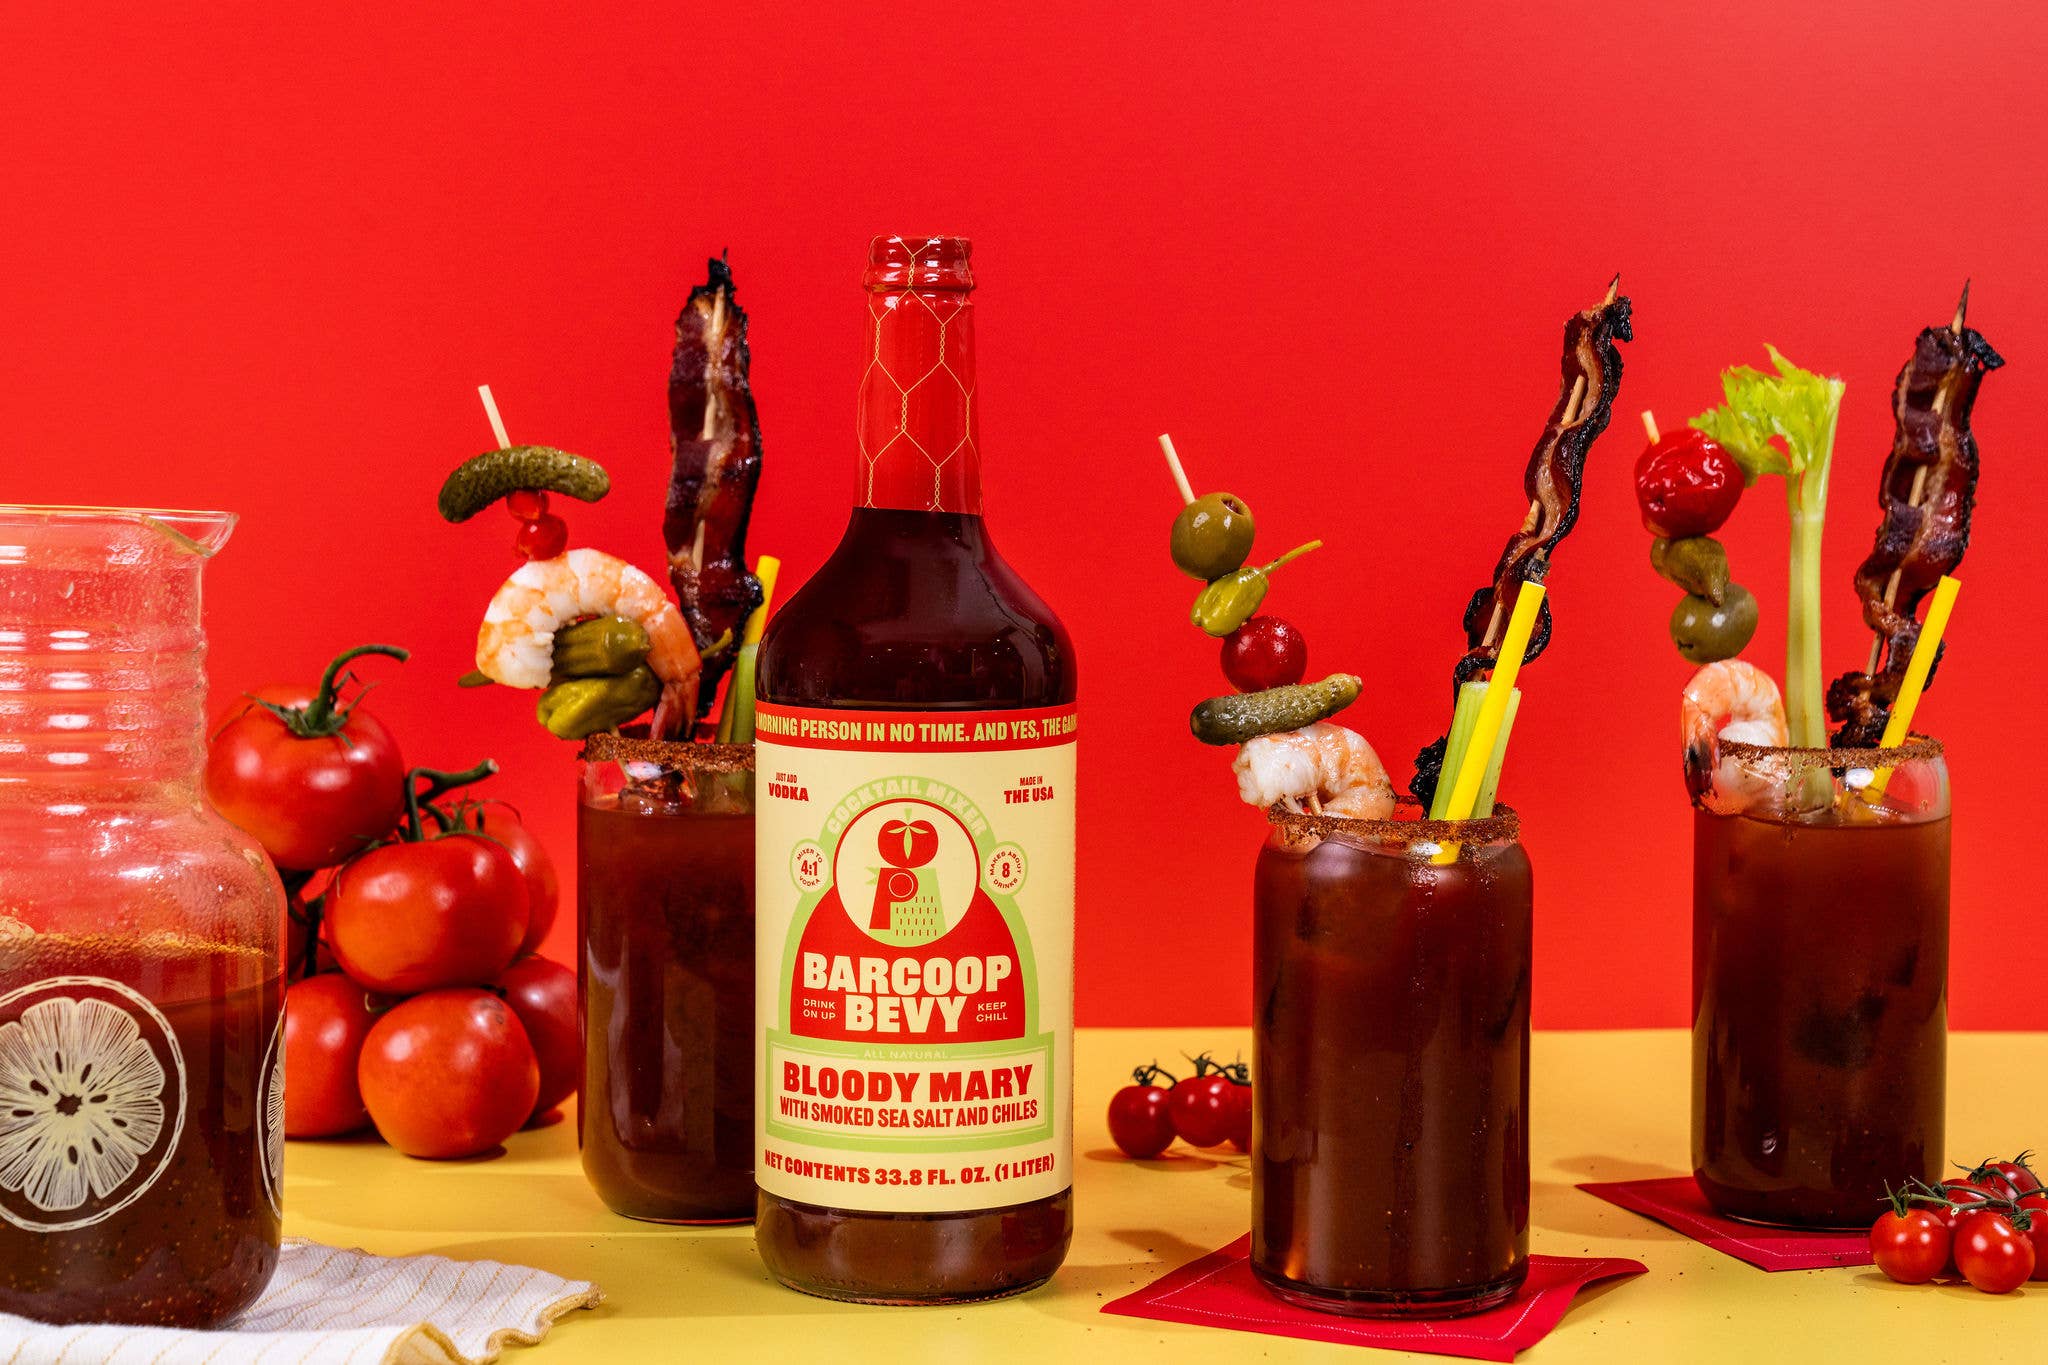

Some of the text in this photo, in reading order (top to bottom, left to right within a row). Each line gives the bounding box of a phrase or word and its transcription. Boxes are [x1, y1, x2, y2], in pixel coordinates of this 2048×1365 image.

[758, 712, 797, 737] MORNING
[801, 720, 861, 741] PERSON
[866, 723, 885, 742] IN
[890, 723, 915, 742] NO
[919, 723, 970, 742] TIME.
[973, 721, 1006, 741] AND
[1010, 719, 1040, 740] YES,
[1042, 717, 1061, 737] THE
[775, 772, 786, 782] JUST
[1020, 775, 1043, 786] MADE IN
[768, 782, 809, 802] VODKA
[1004, 786, 1054, 804] THE USA
[826, 779, 988, 834] COCKTAIL MIXER
[797, 848, 823, 863] MIXER TO
[1007, 851, 1022, 875] ABOUT
[801, 860, 818, 876] 4:1
[1001, 862, 1011, 878] 8
[799, 876, 821, 887] VODKA
[993, 878, 1018, 889] DRINKS
[803, 952, 1012, 996] BARCOOP
[803, 998, 836, 1009] DRINK
[977, 1002, 1007, 1012] KEEP
[803, 1009, 836, 1020] ON UP
[845, 995, 968, 1033] BEVY
[976, 1011, 1008, 1023] CHILL
[864, 1050, 948, 1060] ALL NATURAL
[783, 1061, 1033, 1103] BLOODY MARY
[780, 1096, 1038, 1128] WITH SMOKED SEA SALT AND CHILES
[764, 1149, 1055, 1185] NET CONTENTS 33.8 FL. OZ. (1 LITER)
